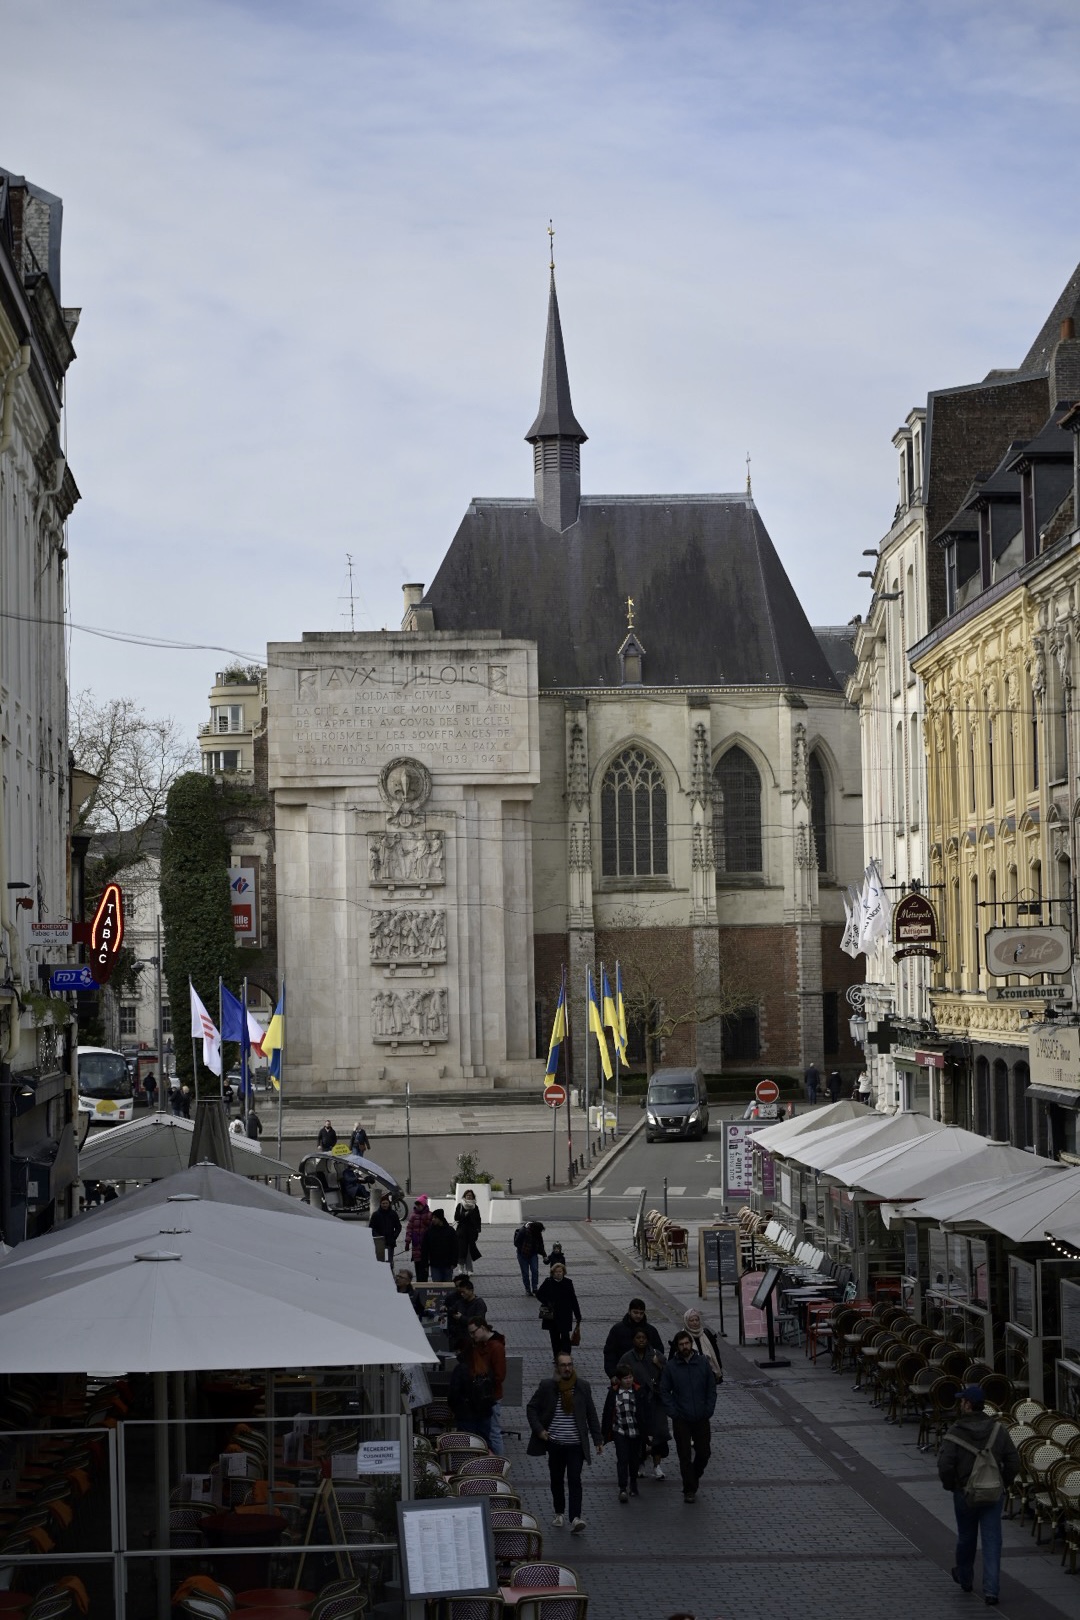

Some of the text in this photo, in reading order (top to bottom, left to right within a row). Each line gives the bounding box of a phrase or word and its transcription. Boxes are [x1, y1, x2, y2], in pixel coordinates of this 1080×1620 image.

[391, 666, 479, 686] LILLOIS
[356, 691, 402, 700] SOLDATS
[414, 690, 452, 700] CIVILS
[296, 707, 310, 715] LA
[394, 706, 405, 714] CE
[412, 704, 478, 714] MONVMENT
[486, 704, 511, 713] AFIN
[296, 720, 310, 728] DE
[317, 719, 373, 728] RAPPELER
[380, 718, 394, 727] AV
[400, 717, 435, 727] COVRS
[440, 717, 459, 726] DES
[367, 732, 378, 740] ET
[386, 731, 405, 740] LES
[412, 730, 490, 739] SOVFFRANCES
[497, 729, 510, 738] DE
[297, 742, 497, 754] SES ENFANTS MORTS POVR LA PAIX
[442, 754, 502, 764] 1939 1945
[898, 908, 932, 920] Métropole
[99, 904, 114, 964] TABAC
[56, 972, 75, 982] FDJ
[996, 987, 1065, 1000] Kronenbourg
